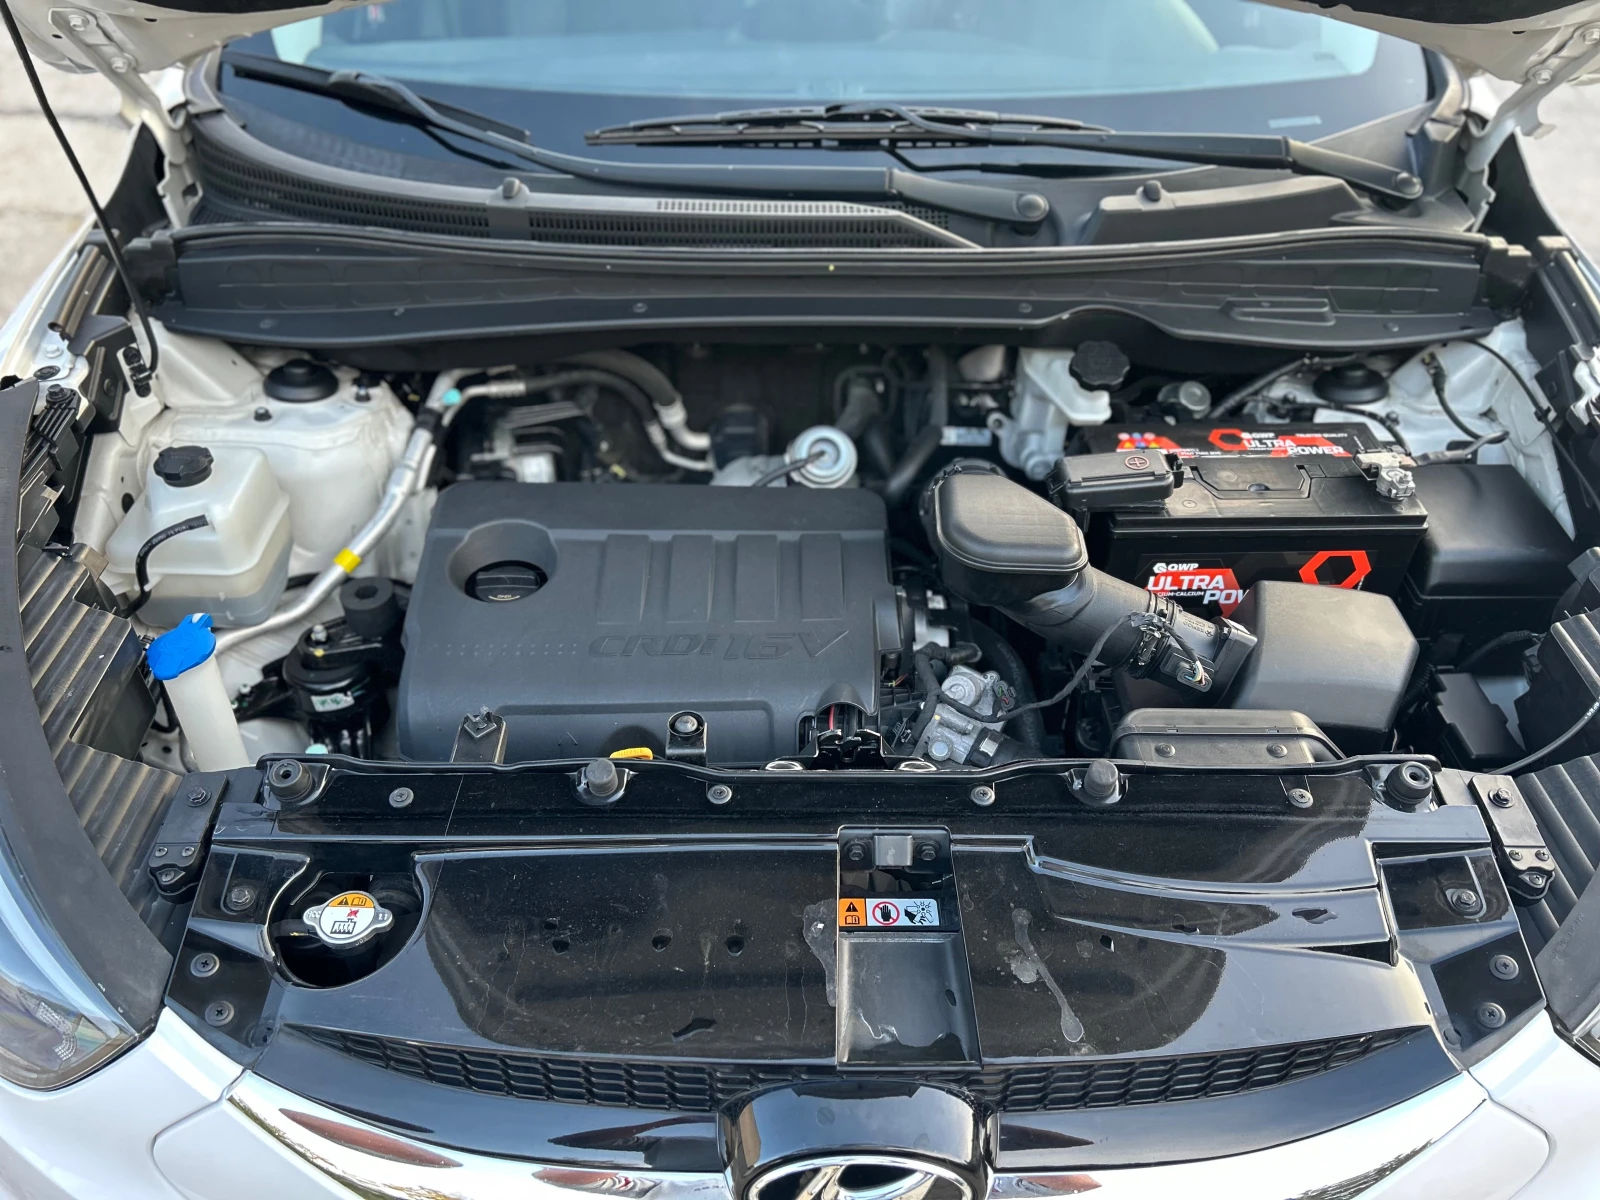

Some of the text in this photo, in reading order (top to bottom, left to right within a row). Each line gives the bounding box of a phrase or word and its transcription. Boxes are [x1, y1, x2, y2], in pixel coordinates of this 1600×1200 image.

[1242, 439, 1296, 448] ULTRA
[1287, 446, 1345, 455] POWER
[1147, 575, 1225, 590] ULTRA
